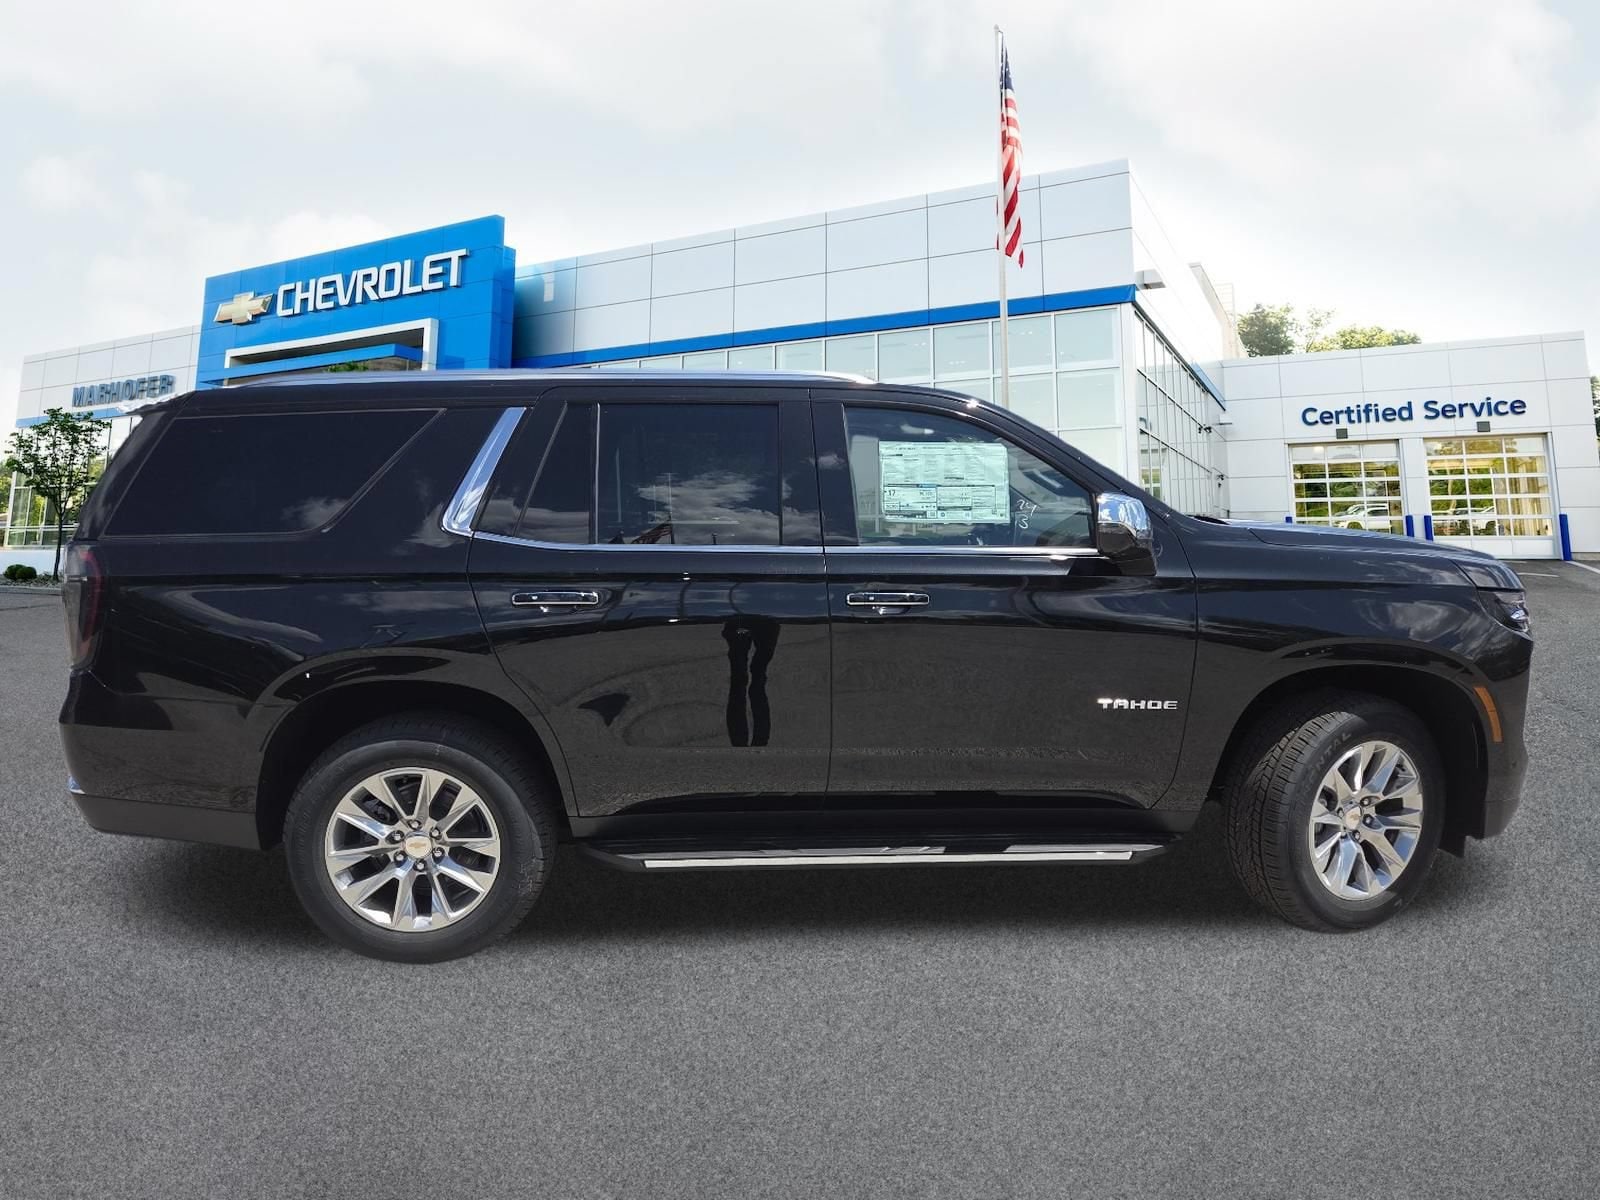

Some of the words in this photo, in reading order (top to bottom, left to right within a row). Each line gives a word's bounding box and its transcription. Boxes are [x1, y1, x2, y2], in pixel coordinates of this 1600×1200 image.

[276, 248, 468, 317] CHEVROLET
[72, 374, 176, 407] MARHOFER
[1301, 401, 1413, 426] Certified
[1423, 396, 1527, 420] Service
[1097, 698, 1178, 709] TAHOE
